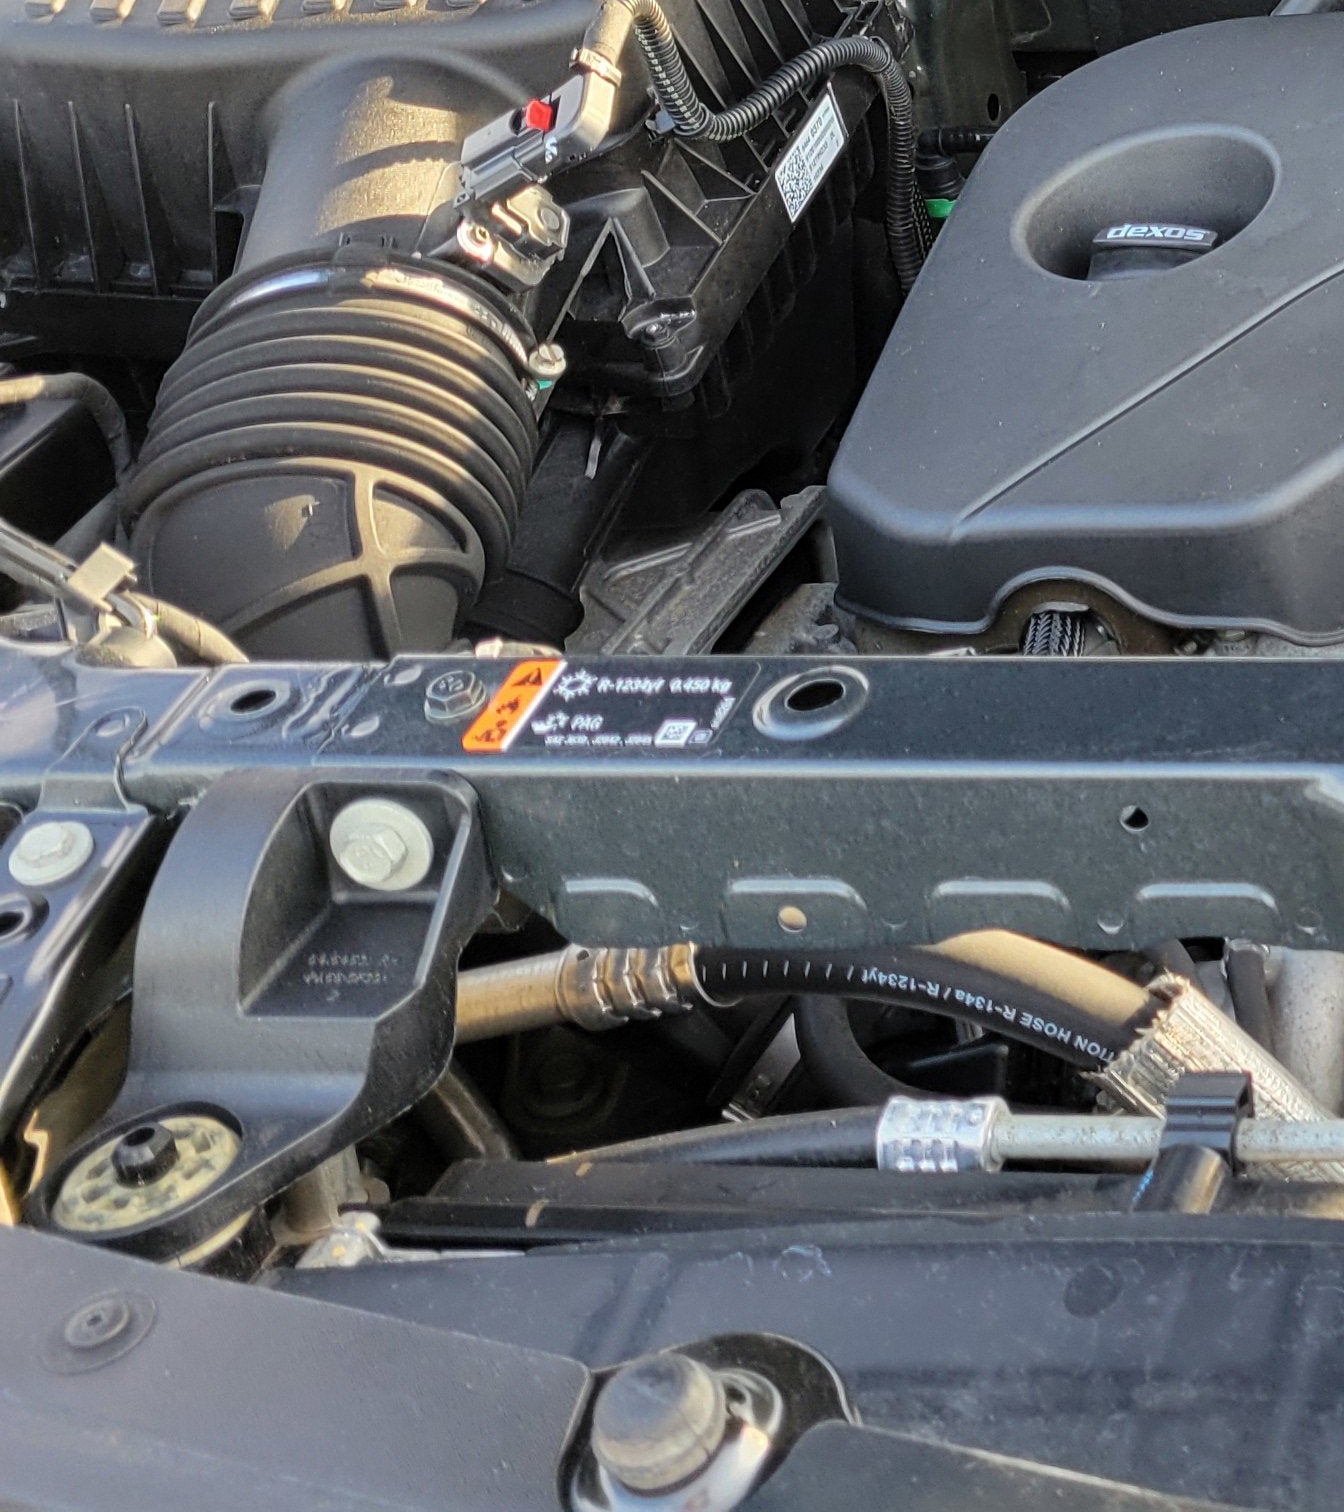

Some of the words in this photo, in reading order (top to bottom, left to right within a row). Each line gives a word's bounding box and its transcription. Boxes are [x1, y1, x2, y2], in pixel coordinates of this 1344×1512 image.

[1107, 223, 1206, 241] dexos
[571, 714, 604, 731] PAG
[861, 966, 940, 998] R-1234yf
[954, 988, 1016, 1023] R-134a
[1018, 1011, 1071, 1044] HOSE
